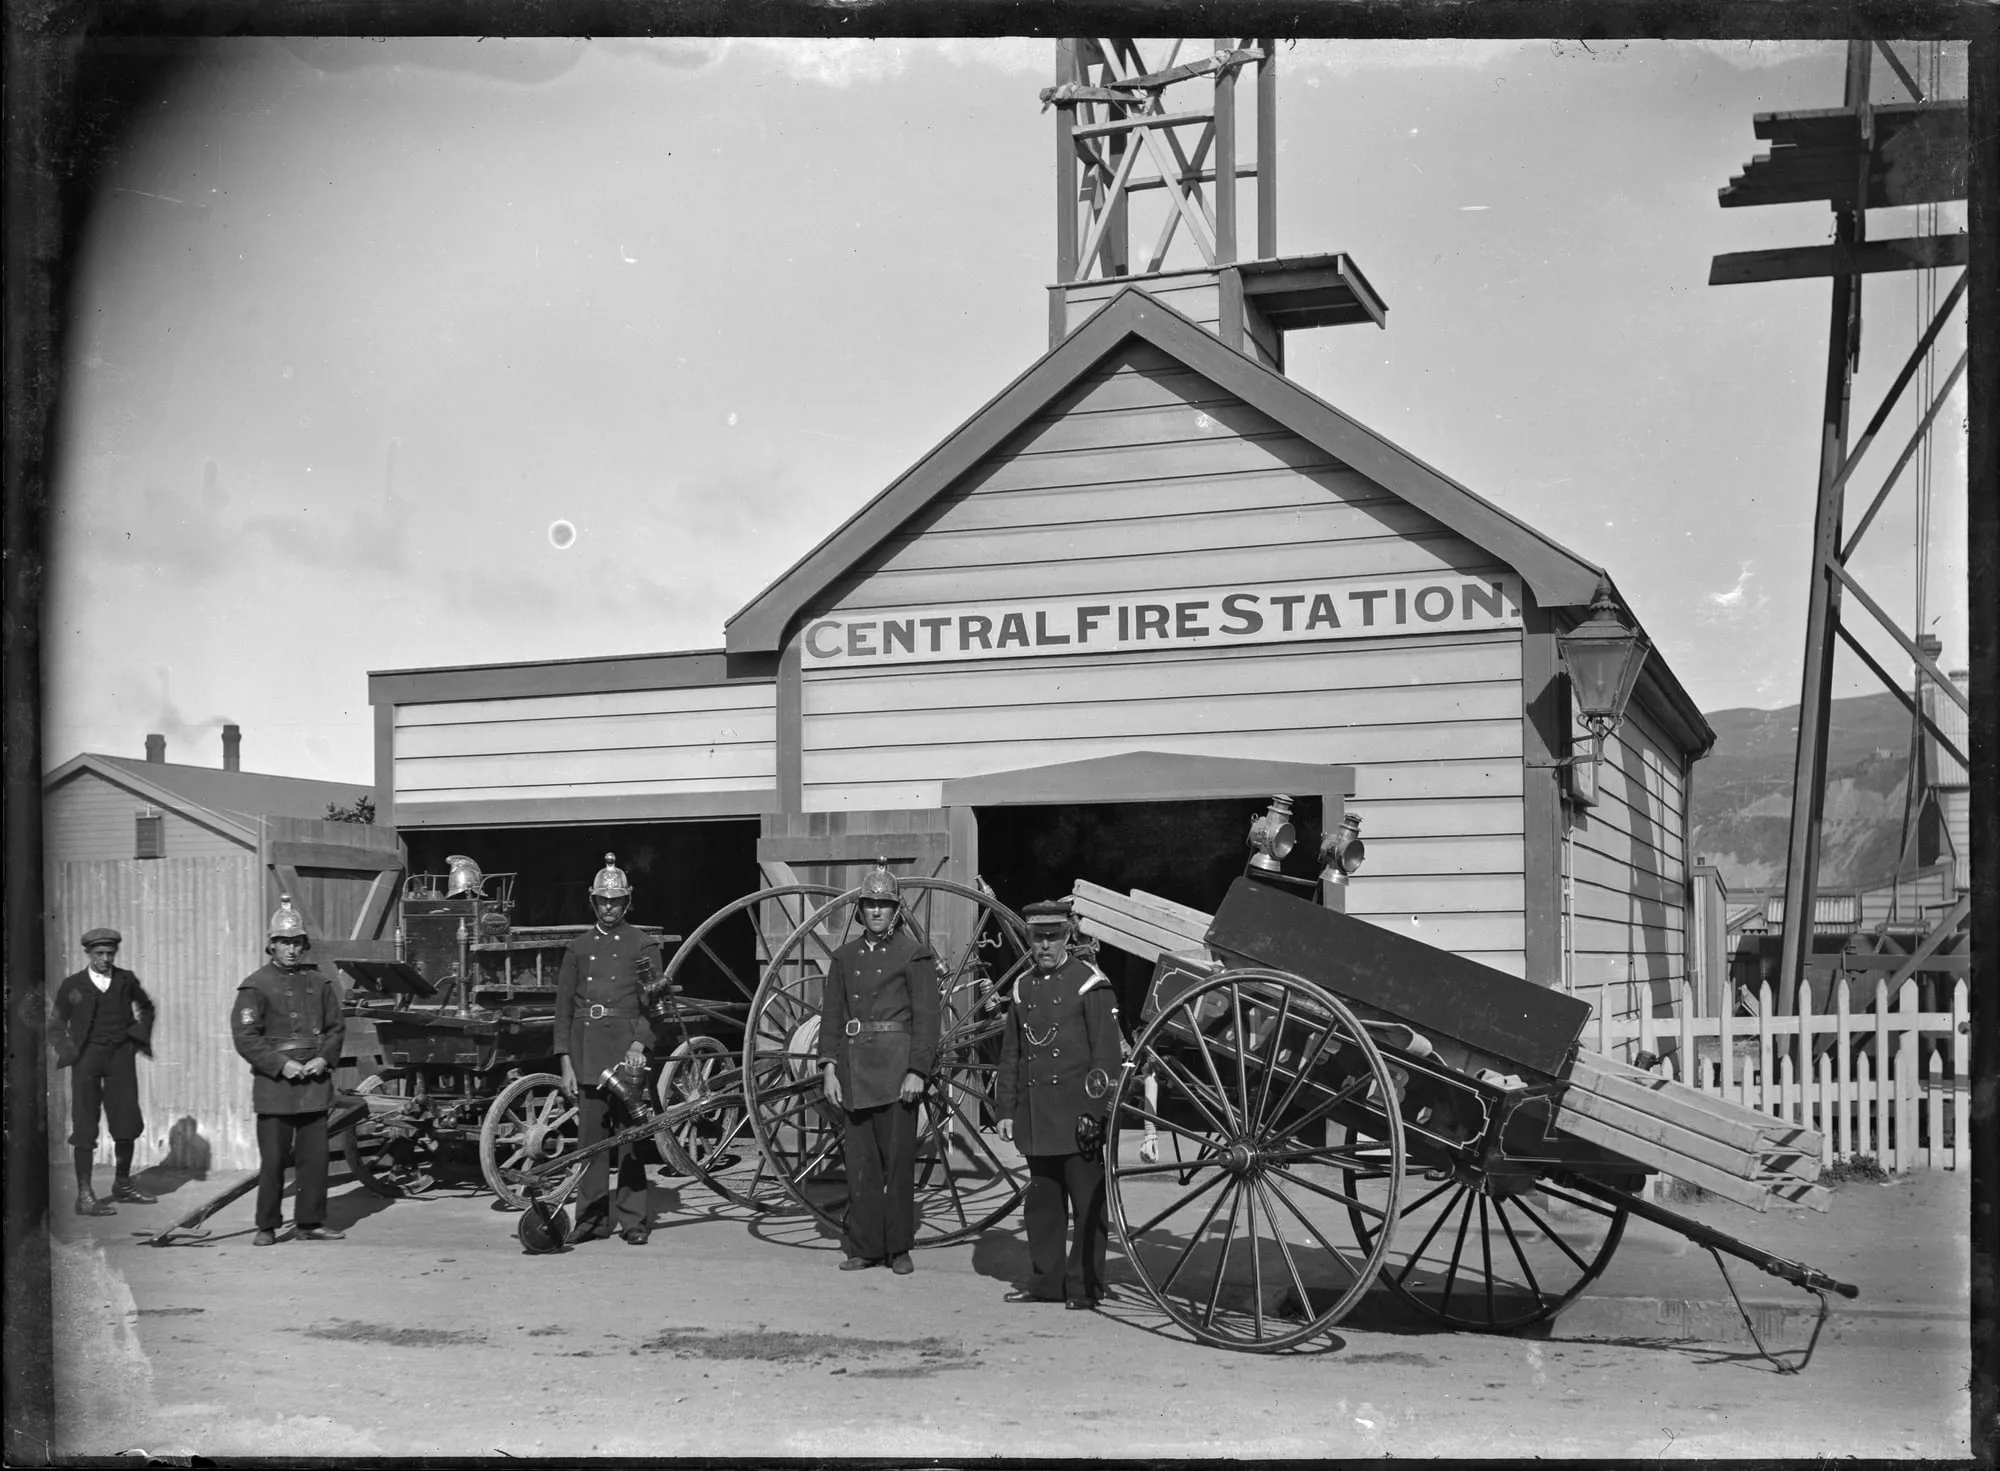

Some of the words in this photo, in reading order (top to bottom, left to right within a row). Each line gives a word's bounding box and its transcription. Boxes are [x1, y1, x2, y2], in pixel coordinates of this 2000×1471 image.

[805, 611, 1071, 658] CENTRAL
[1078, 601, 1211, 643] FIRE
[1218, 582, 1520, 635] STATION.
